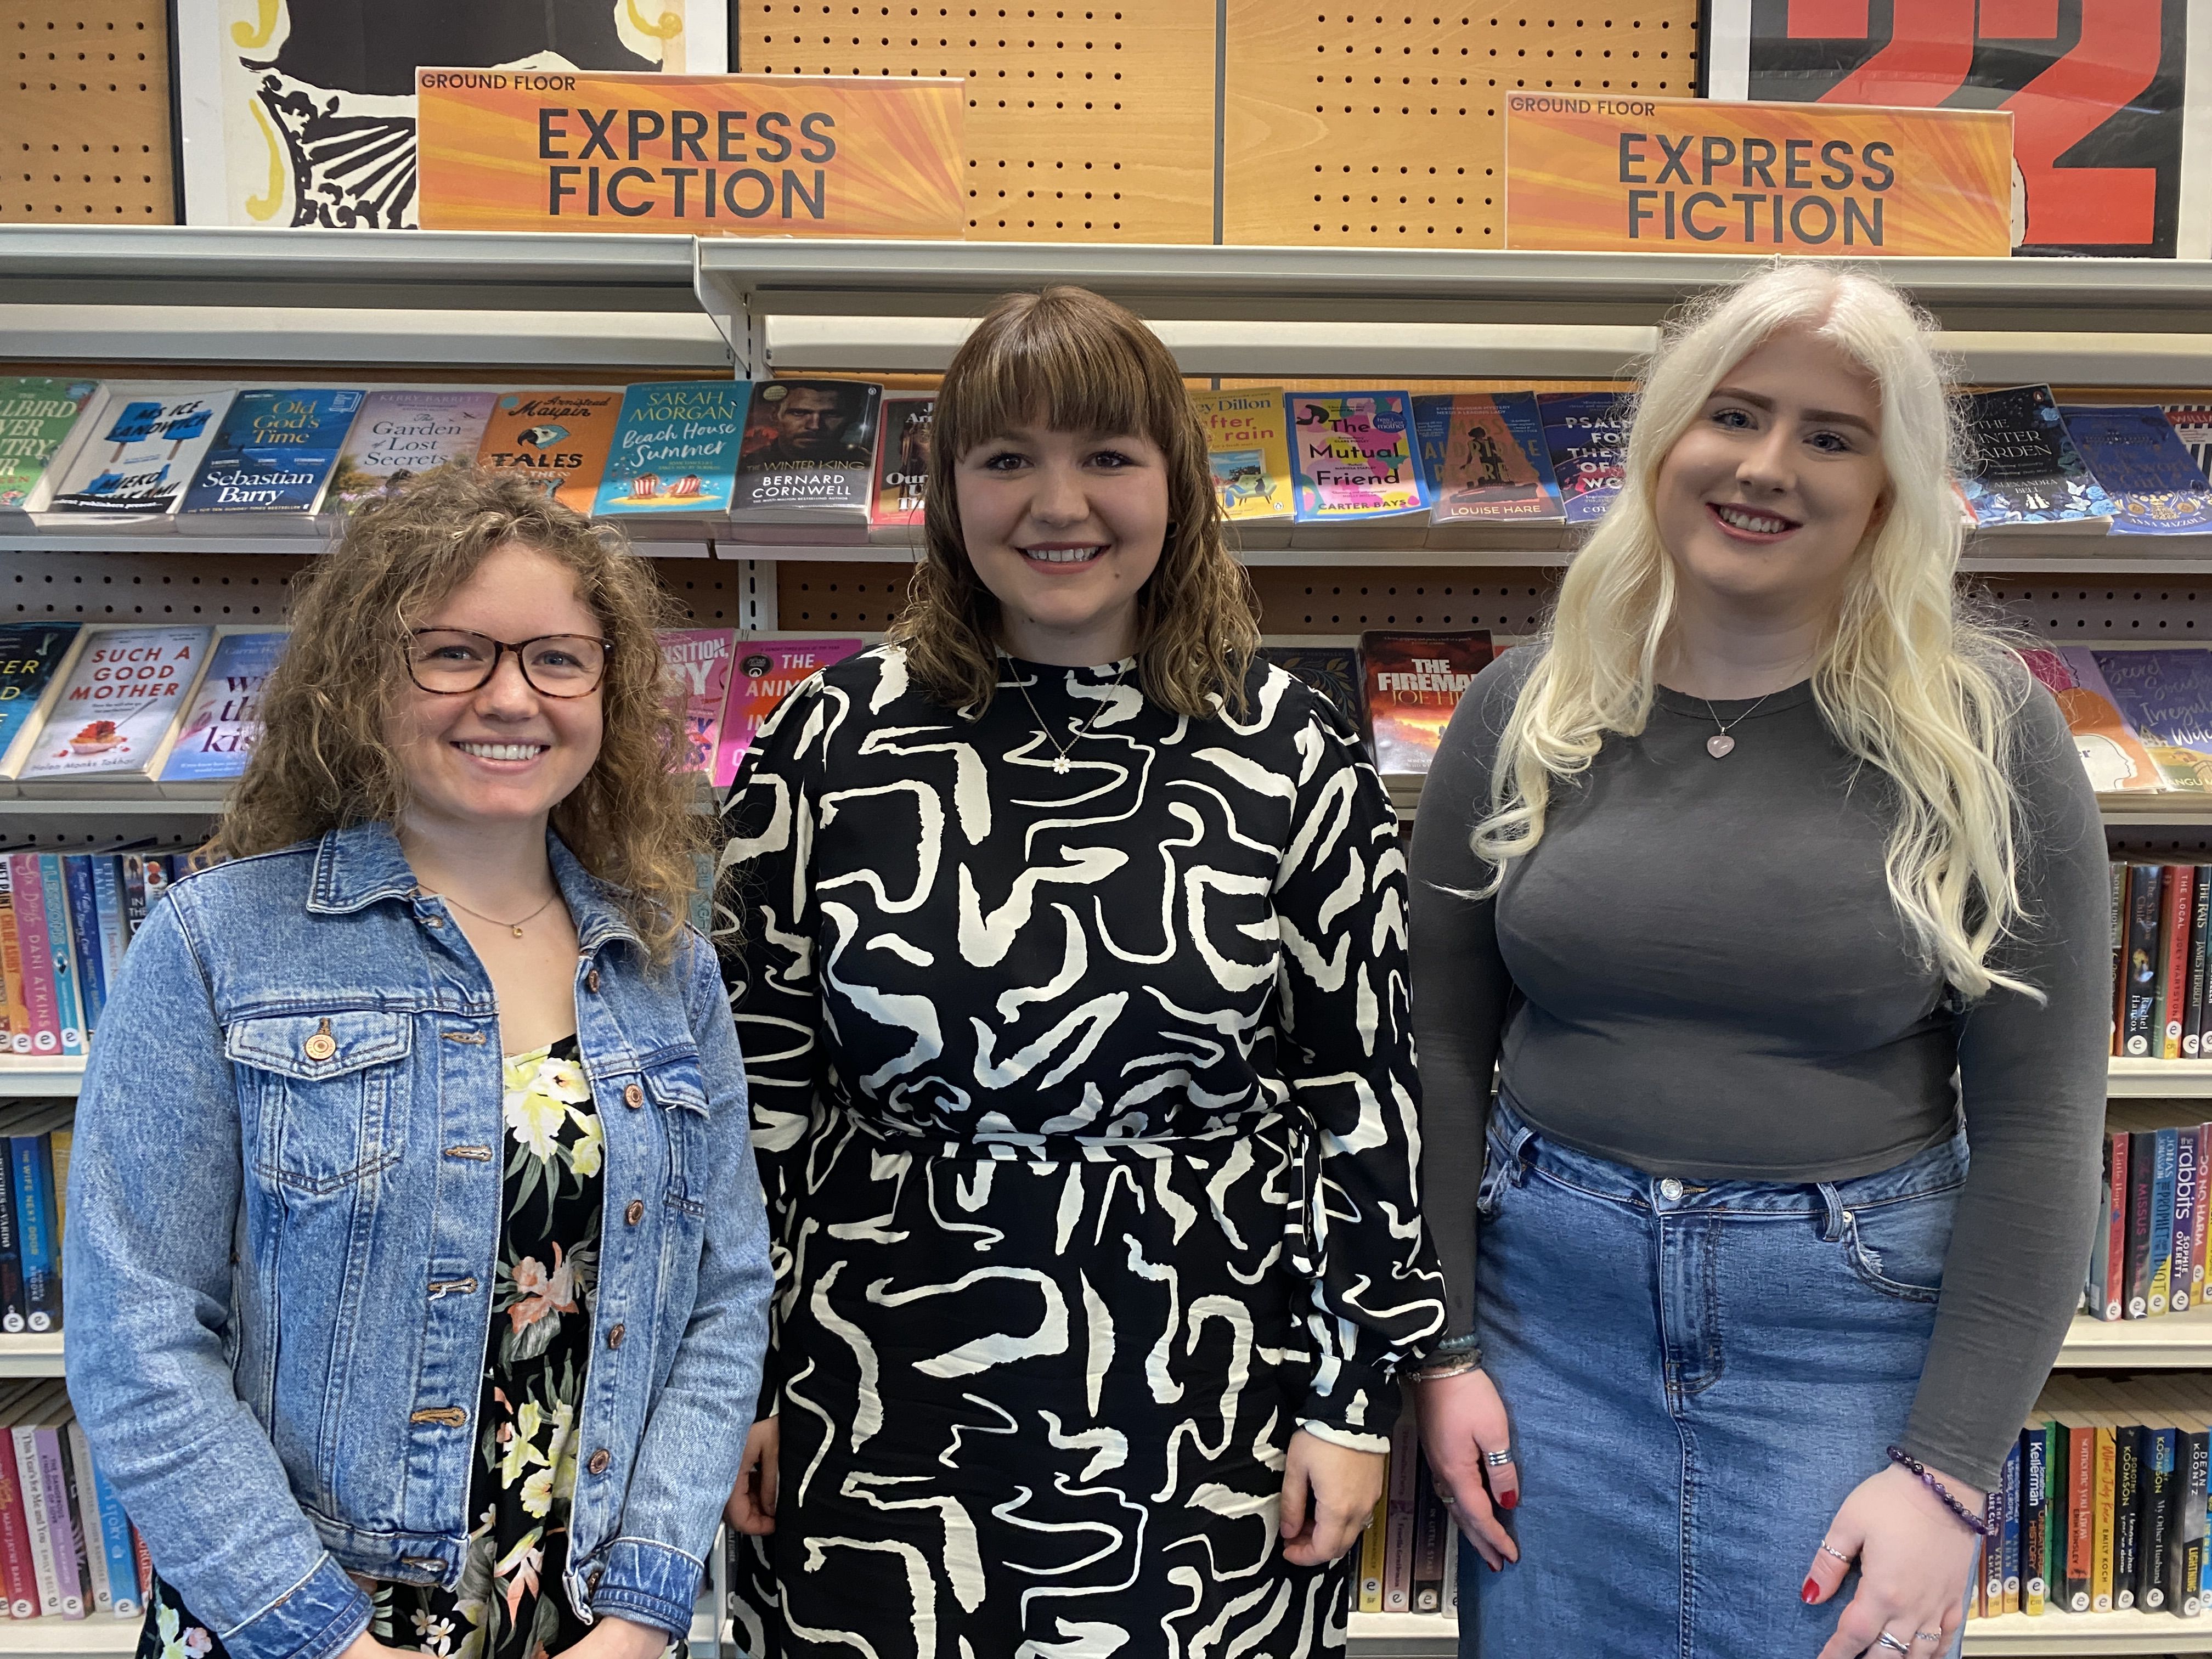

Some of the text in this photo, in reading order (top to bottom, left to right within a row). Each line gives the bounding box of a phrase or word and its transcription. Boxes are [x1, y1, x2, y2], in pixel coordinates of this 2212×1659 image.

[421, 74, 577, 92] GROUND FLOOR
[1511, 96, 1656, 117] GROUND FLOOR
[538, 108, 837, 163] EXPRESS
[1619, 132, 1895, 191] EXPRESS
[549, 166, 826, 219] FICTION
[1627, 190, 1884, 247] FICTION
[169, 401, 203, 416] ICE
[272, 400, 317, 414] Old
[544, 396, 611, 407] Armistead
[646, 391, 724, 407] SARAH
[1218, 398, 1272, 411] Dillon
[509, 400, 591, 420] Maupin
[629, 405, 735, 422] MORGAN
[253, 415, 320, 429] God's
[373, 421, 461, 436] Garden
[1328, 419, 1370, 433] The
[1976, 419, 2010, 429] THE
[252, 430, 310, 443] Time
[387, 437, 438, 451] Lost
[623, 421, 737, 449] Beach House
[1225, 426, 1274, 441] rain
[364, 452, 449, 466] Secrets
[492, 453, 584, 468] TALES
[630, 439, 728, 468] Summer
[1310, 443, 1400, 459] Mutual
[1567, 447, 1612, 459] THE
[764, 460, 865, 471] WINTER KING
[1580, 462, 1611, 473] OF
[202, 470, 314, 488] Sebastian
[763, 475, 845, 486] BERNARD
[1317, 469, 1400, 486] Friend
[1994, 479, 2058, 488] ALEXANDRA
[217, 487, 284, 505] Barry
[752, 486, 851, 498] CORNWELL
[1318, 499, 1406, 510] CARTER BAYS
[1451, 505, 1542, 516] LOUISE HARE
[2130, 516, 2207, 528] ANNA MAZZOLA
[92, 645, 190, 663] SUCH A
[782, 653, 815, 669] THE
[94, 665, 174, 681] GOOD
[1411, 658, 1452, 674] THE
[69, 682, 180, 701] MOTHER
[1392, 690, 1431, 706] JOE
[103, 863, 117, 905] ETHAN
[2112, 873, 2120, 906] NOELLE
[21, 890, 42, 928] Days
[128, 907, 146, 916] THE
[2136, 895, 2146, 924] Child
[2144, 879, 2158, 940] The Shadow
[2177, 898, 2186, 929] LOCAL
[2196, 882, 2209, 928] THE RATS
[28, 935, 52, 1027] DANI ATKINS
[2192, 941, 2205, 1007] JAMES HERBERT
[2130, 995, 2140, 1032] Hancox
[2139, 997, 2149, 1030] Rachel
[2157, 1136, 2165, 1180] JONASSON
[2165, 1136, 2174, 1178] JONAS
[2176, 1145, 2197, 1219] rabbits
[22, 1161, 40, 1255] WIFE NEXT DOOR
[2136, 1183, 2148, 1236] MISSUS
[2194, 1204, 2205, 1246] HARM
[2153, 1192, 2171, 1292] PROPHET IDIOT
[2175, 1231, 2183, 1278] OVERETT
[2181, 1235, 2190, 1274] SOPHIE
[30, 1265, 41, 1301] BROOKE
[22, 1433, 34, 1454] This
[42, 1454, 53, 1491] KINGDOM
[2029, 1442, 2042, 1506] Kellerman
[2122, 1445, 2131, 1506] KOOMSON
[2154, 1436, 2165, 1494] KOOMSON
[2191, 1443, 2200, 1496] KOONTZ
[2199, 1451, 2208, 1486] DEAN
[2078, 1438, 2090, 1539] someone you know
[2101, 1446, 2115, 1524] What Knew
[33, 1494, 42, 1508] Me
[35, 1510, 44, 1525] and
[37, 1525, 48, 1544] You
[2029, 1520, 2038, 1568] HISTORY
[2153, 1500, 2165, 1584] My Other Husband
[2, 1513, 22, 1593] MARY JAYNE BAKER
[2072, 1530, 2080, 1564] KINSLEY
[2120, 1549, 2128, 1573] done
[2187, 1547, 2199, 1593] LIGHTNING
[44, 1575, 54, 1595] BELL
